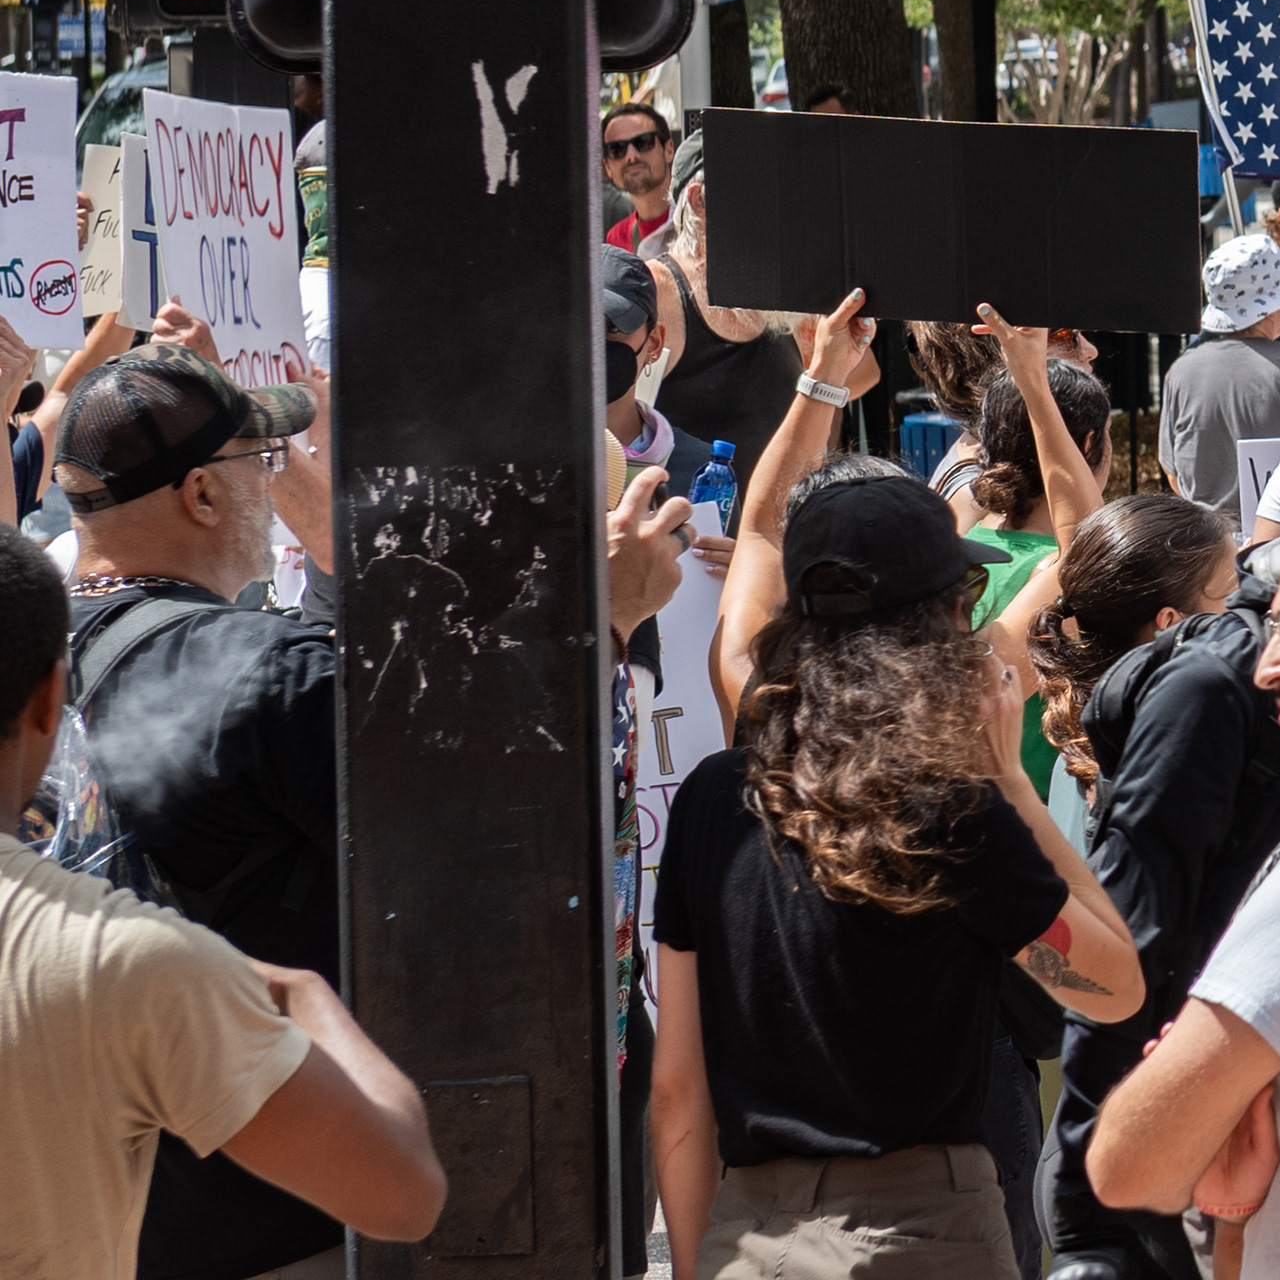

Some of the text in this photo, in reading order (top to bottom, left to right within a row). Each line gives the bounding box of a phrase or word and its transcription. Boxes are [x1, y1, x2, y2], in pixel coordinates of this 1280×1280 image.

[93, 209, 120, 239] FUC
[155, 118, 284, 241] DEMOCRACY
[200, 235, 261, 330] OVER
